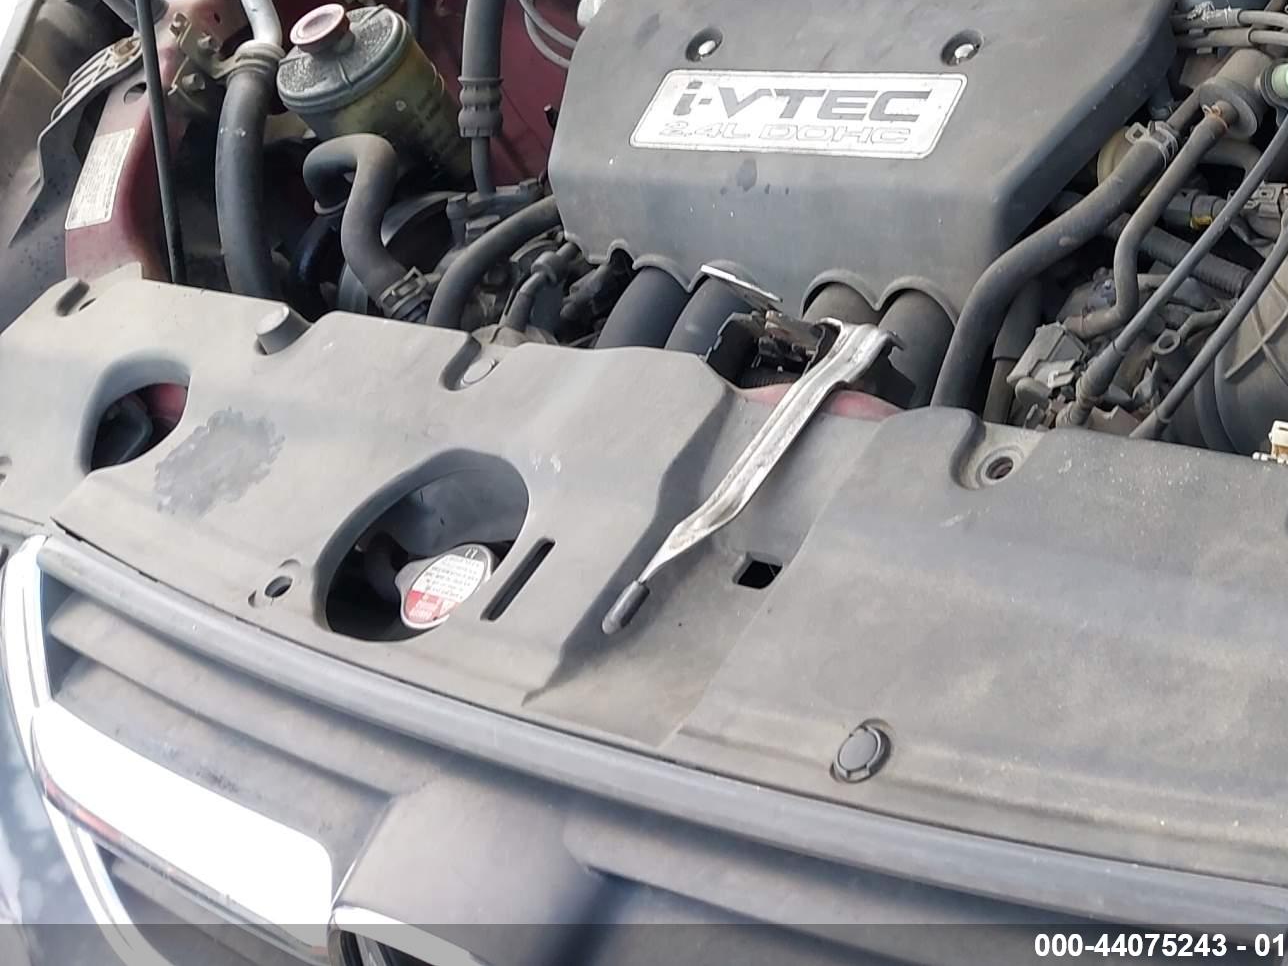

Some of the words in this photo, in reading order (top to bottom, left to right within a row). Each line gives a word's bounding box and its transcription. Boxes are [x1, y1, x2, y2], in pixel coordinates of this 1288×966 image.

[673, 80, 932, 122] i-VTEC
[659, 121, 751, 139] 2.4L
[758, 123, 910, 144] DOHC
